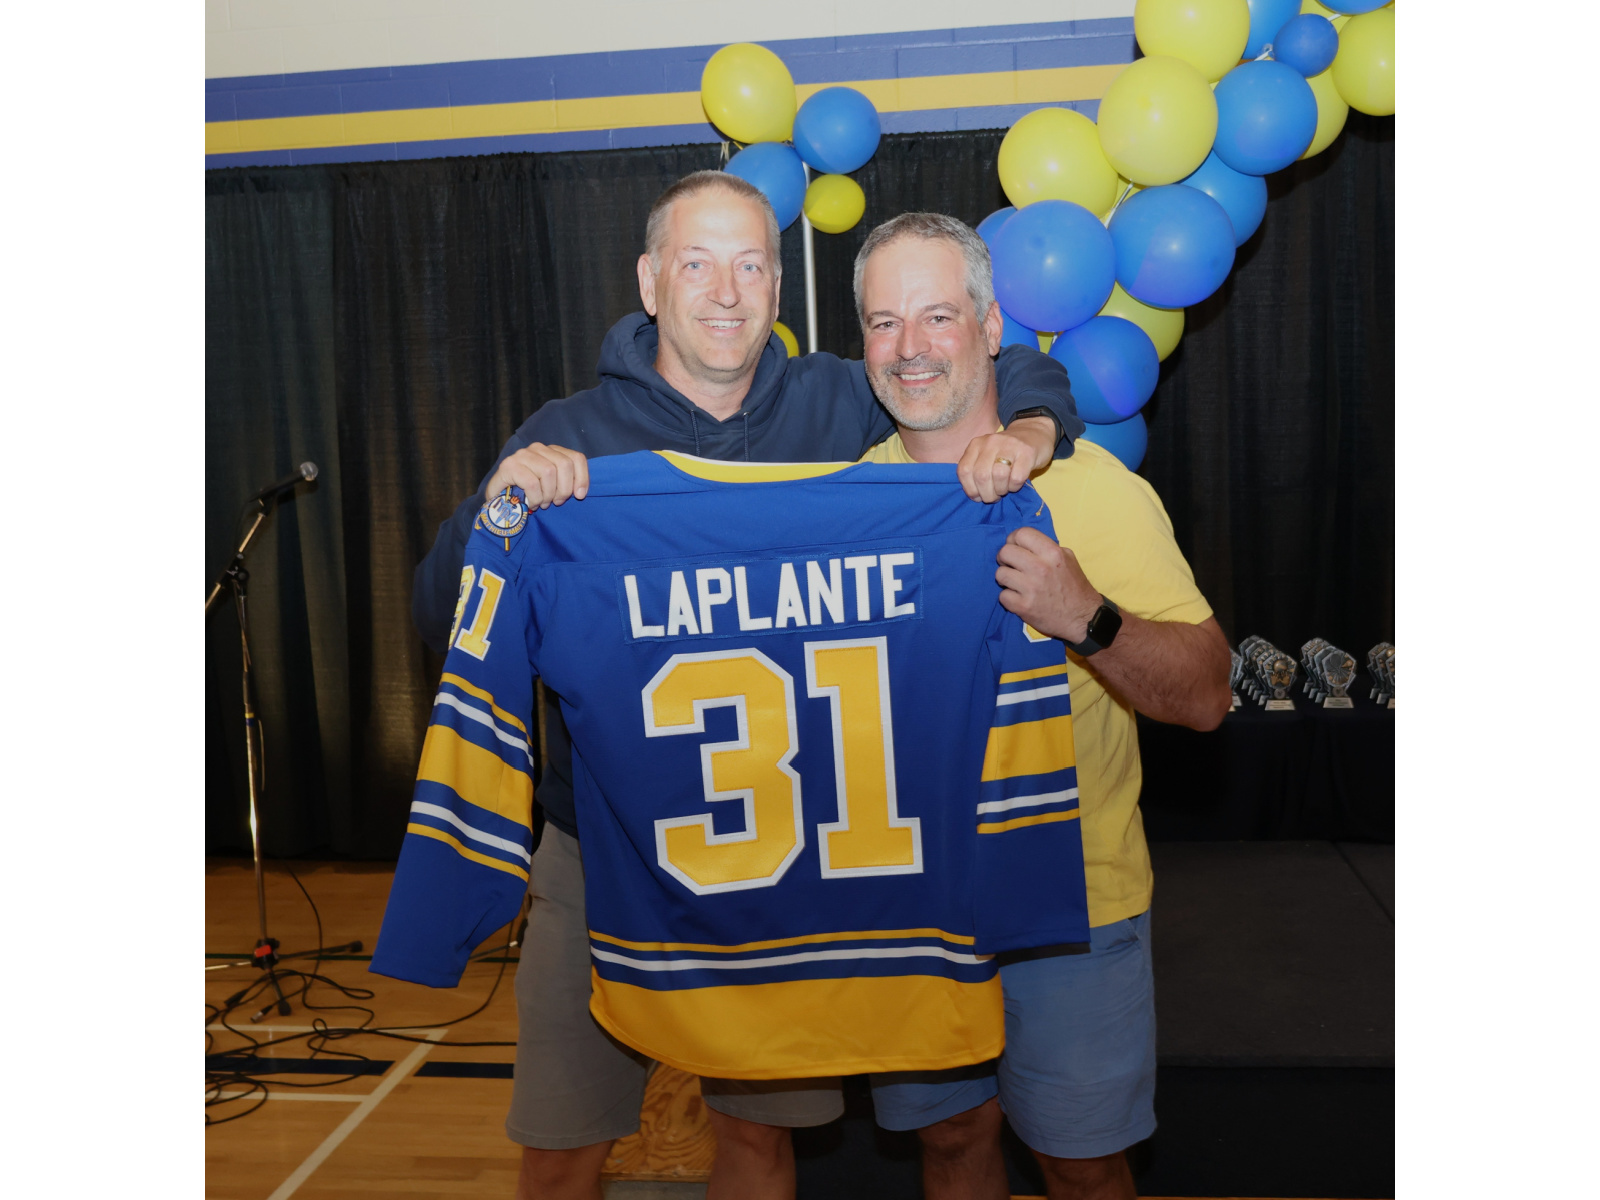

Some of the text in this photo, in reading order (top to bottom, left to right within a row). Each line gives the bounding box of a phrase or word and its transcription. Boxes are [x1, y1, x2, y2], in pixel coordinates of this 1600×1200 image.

[479, 511, 529, 537] MATHIEU-MARTIN
[624, 552, 915, 639] LAPLANTE
[641, 636, 924, 896] 31
